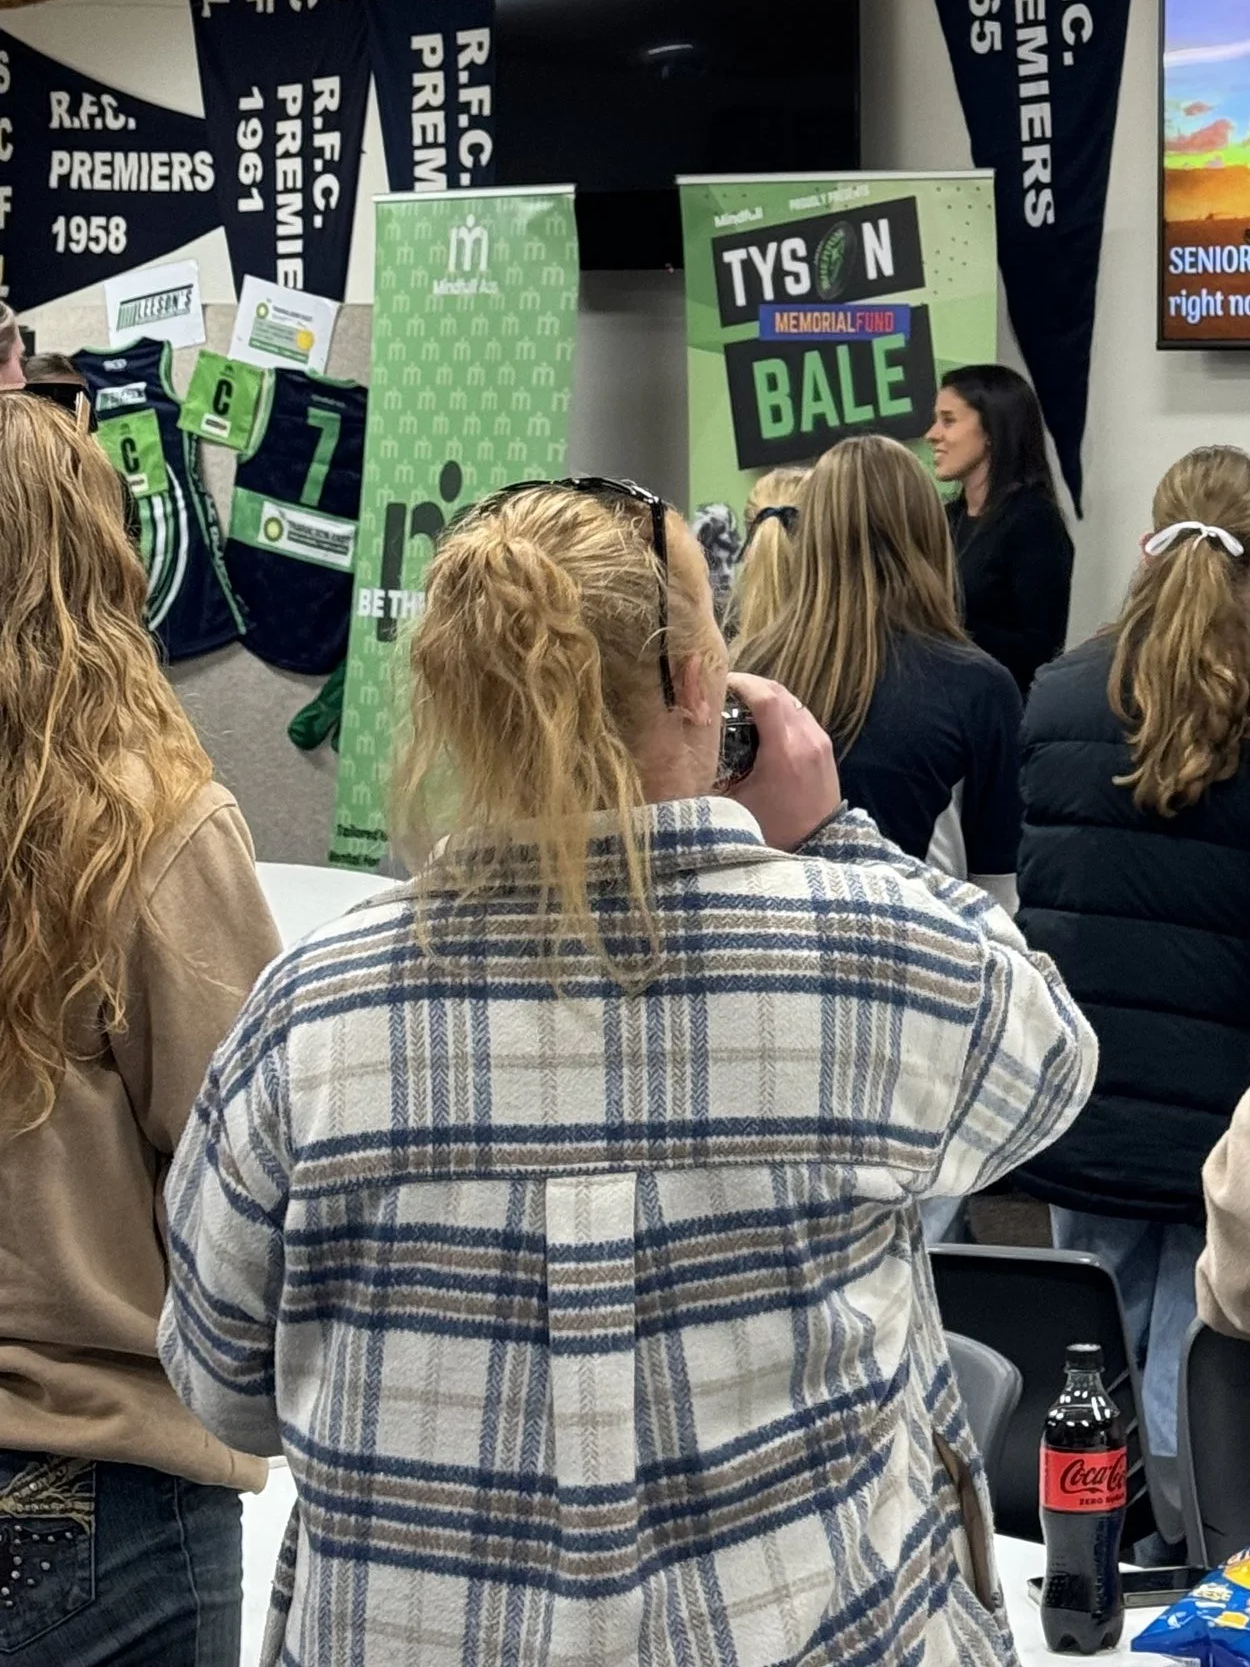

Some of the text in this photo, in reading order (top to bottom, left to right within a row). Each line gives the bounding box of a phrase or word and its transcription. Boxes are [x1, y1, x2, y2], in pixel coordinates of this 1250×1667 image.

[50, 90, 136, 130] R.F.C.
[456, 27, 493, 186] R.F.C.
[48, 150, 215, 192] PREMIERS
[237, 86, 264, 213] 1961
[312, 75, 340, 229] R.F.C.
[52, 215, 127, 255] 1958
[1168, 288, 1224, 324] right
[752, 333, 912, 440] BALE
[301, 407, 341, 507] 7
[357, 588, 385, 617] BE
